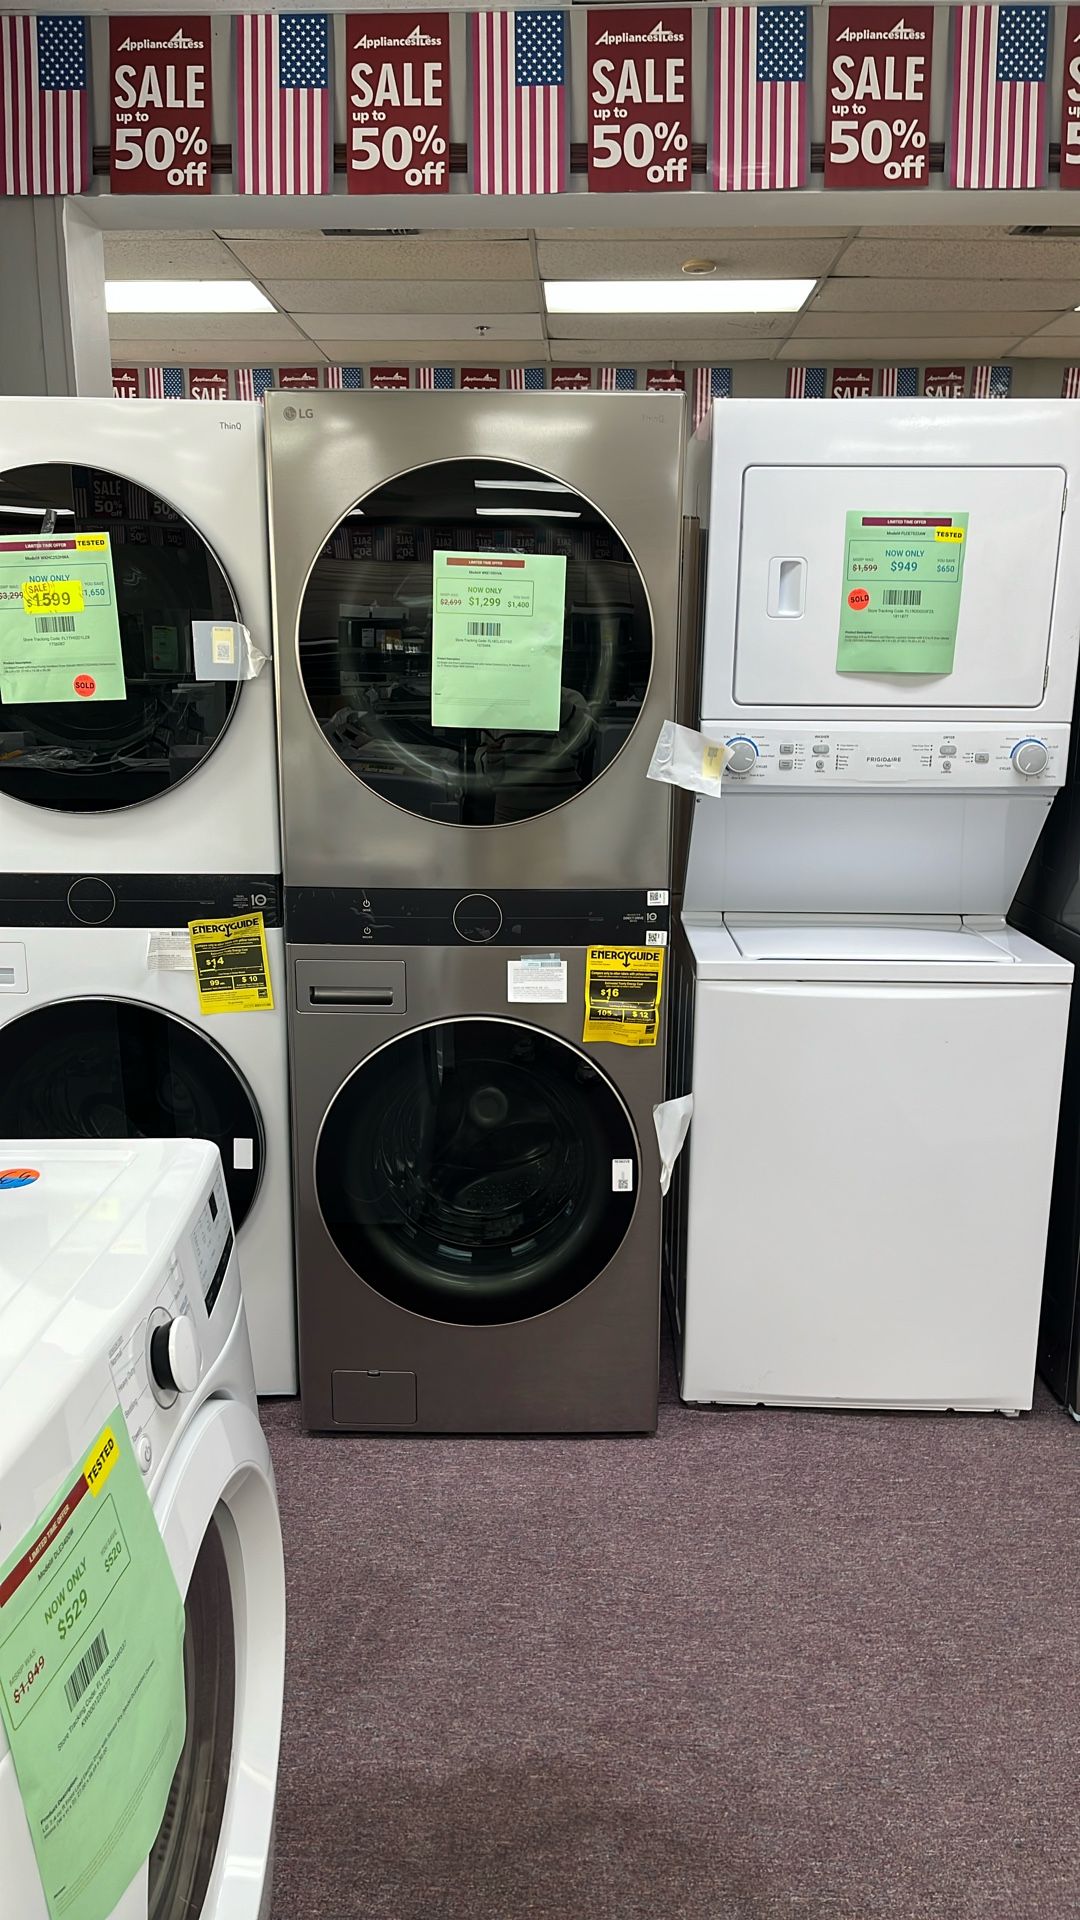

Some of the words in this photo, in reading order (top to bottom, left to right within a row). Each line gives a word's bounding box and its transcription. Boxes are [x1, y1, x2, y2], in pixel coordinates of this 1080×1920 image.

[351, 62, 442, 107] SALE
[591, 58, 685, 103] SALE
[831, 55, 925, 101] SALE
[114, 65, 204, 109] SALE
[116, 112, 132, 124] up
[135, 112, 149, 122] to
[352, 110, 369, 123] up
[370, 110, 386, 121] to
[593, 107, 611, 121] up
[613, 106, 628, 118] to
[832, 104, 850, 117] up
[851, 103, 866, 115] to
[115, 127, 208, 171] 50%
[352, 125, 446, 171] 50%
[592, 121, 688, 169] 50%
[830, 119, 926, 165] 50%
[167, 162, 207, 186] off
[405, 161, 445, 186] off
[646, 157, 688, 184] off
[883, 154, 925, 181] off
[112, 387, 137, 399] ALE
[191, 387, 227, 400] SALE
[298, 408, 314, 419] LG
[219, 421, 241, 431] ThinQ
[93, 480, 121, 496] SALE
[77, 539, 105, 547] TESTED
[937, 531, 962, 539] TESTED
[890, 561, 918, 572] $949
[937, 565, 955, 573] $650
[29, 575, 48, 583] NOW
[50, 574, 70, 582] ONLY
[28, 584, 47, 593] SALE
[82, 588, 105, 597] 1,650
[468, 597, 501, 608] $1,299
[507, 601, 530, 609] $1,400
[850, 594, 869, 604] SOLD
[251, 895, 267, 906] 10
[192, 918, 259, 935] ENERGYGUIDE
[206, 956, 224, 966] $14
[591, 950, 660, 967] ENERGYGUIDE
[601, 988, 619, 997] $16
[87, 1438, 114, 1485] TESTED
[29, 1536, 47, 1563] LIMITED
[47, 1521, 58, 1538] TIME
[57, 1504, 70, 1524] OFFER
[104, 1541, 122, 1573] $520
[44, 1592, 65, 1625] NOW
[66, 1557, 87, 1592] ONLY
[57, 1589, 88, 1640] $529
[13, 1656, 46, 1703] $1,049
[57, 1732, 69, 1751] Store
[69, 1706, 86, 1733] Tracking
